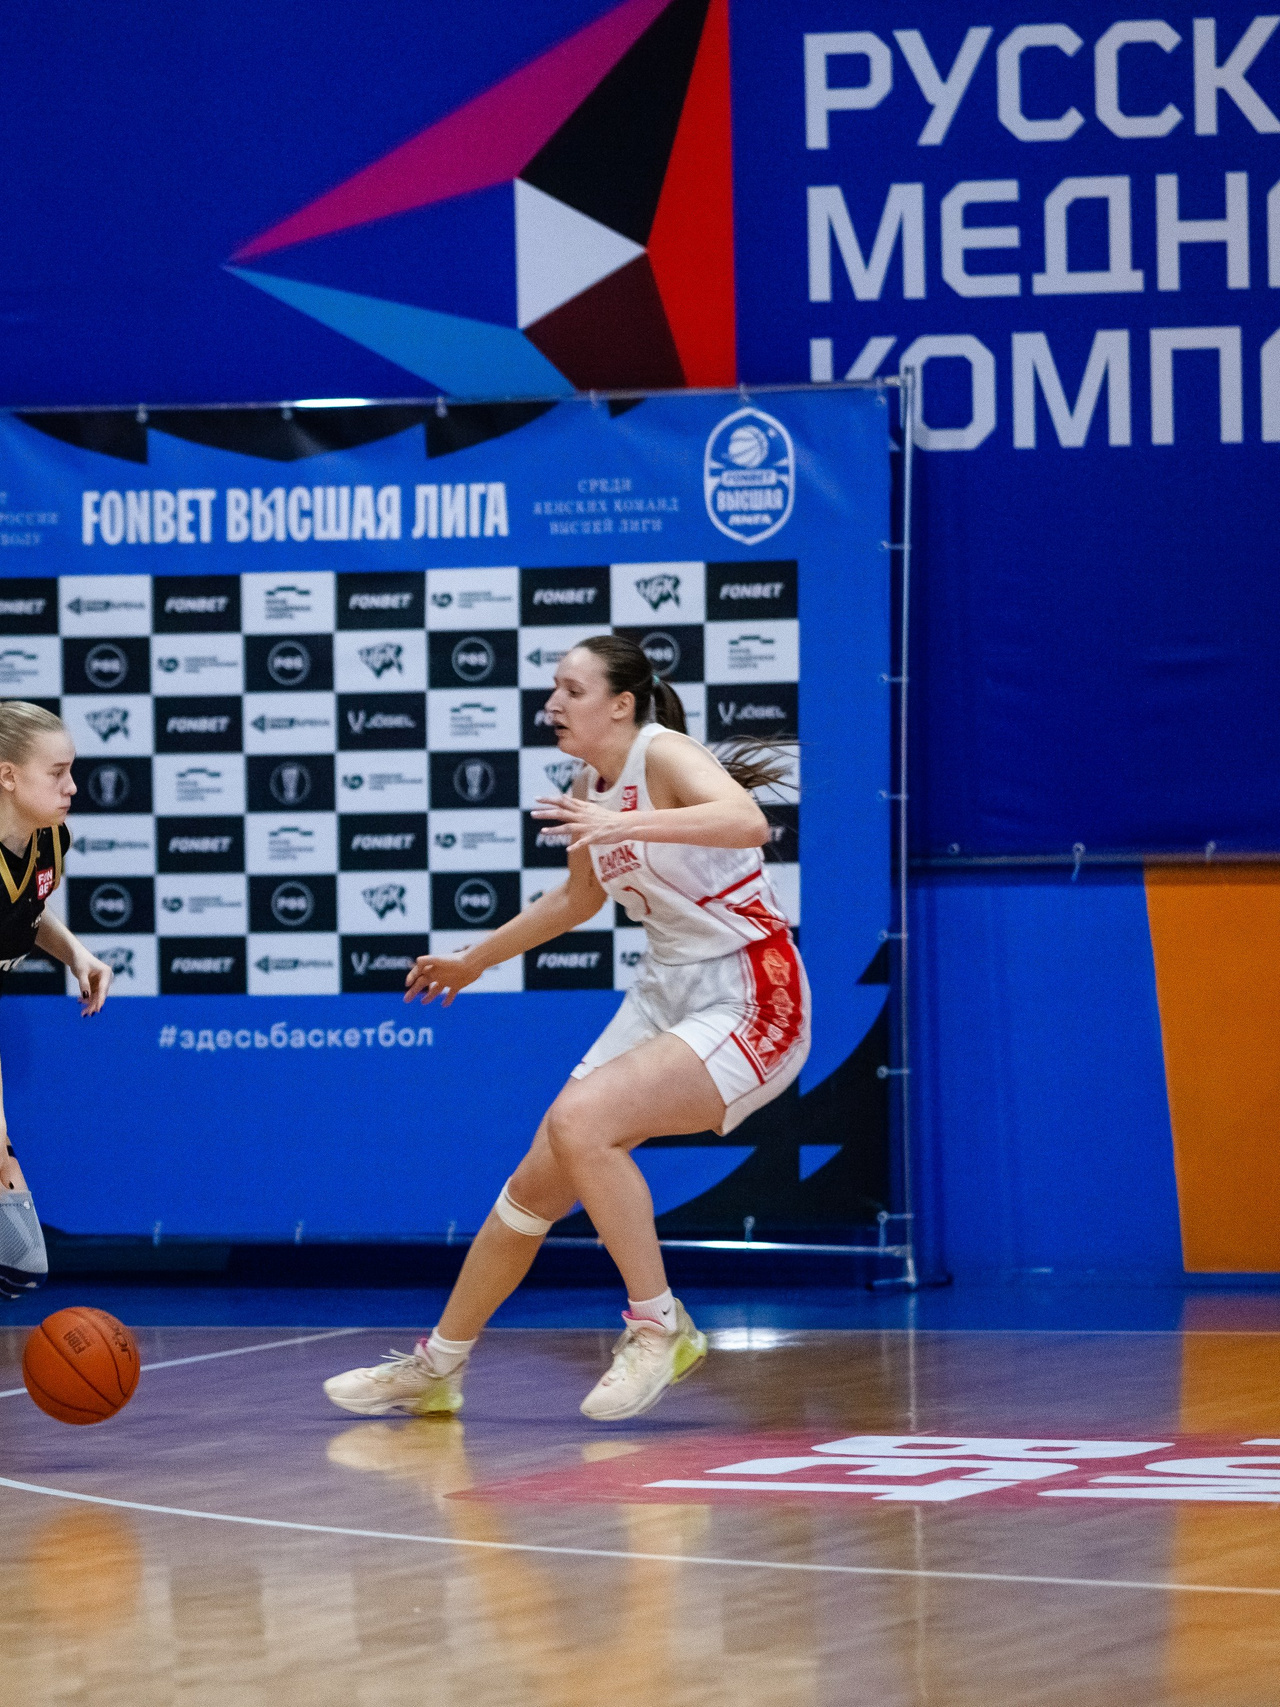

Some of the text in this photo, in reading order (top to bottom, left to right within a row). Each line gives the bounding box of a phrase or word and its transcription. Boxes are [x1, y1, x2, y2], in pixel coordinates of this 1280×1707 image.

[803, 15, 1280, 150] РУССК
[807, 171, 1280, 302] МЕДН
[810, 326, 1280, 452] ОМП
[82, 481, 509, 546] FONBET ВЫСШАЯ ЛИГА
[533, 588, 597, 605] FONBET
[719, 582, 784, 600] FONBET
[165, 596, 228, 613] FONBET
[349, 593, 412, 610] FONBET
[166, 716, 230, 733] FONBET
[169, 836, 232, 853] FONBET
[351, 833, 416, 850] FONBET
[171, 957, 235, 973] FONBET
[536, 952, 601, 969] FONBET
[157, 1019, 435, 1052] #здесьбаскетбол
